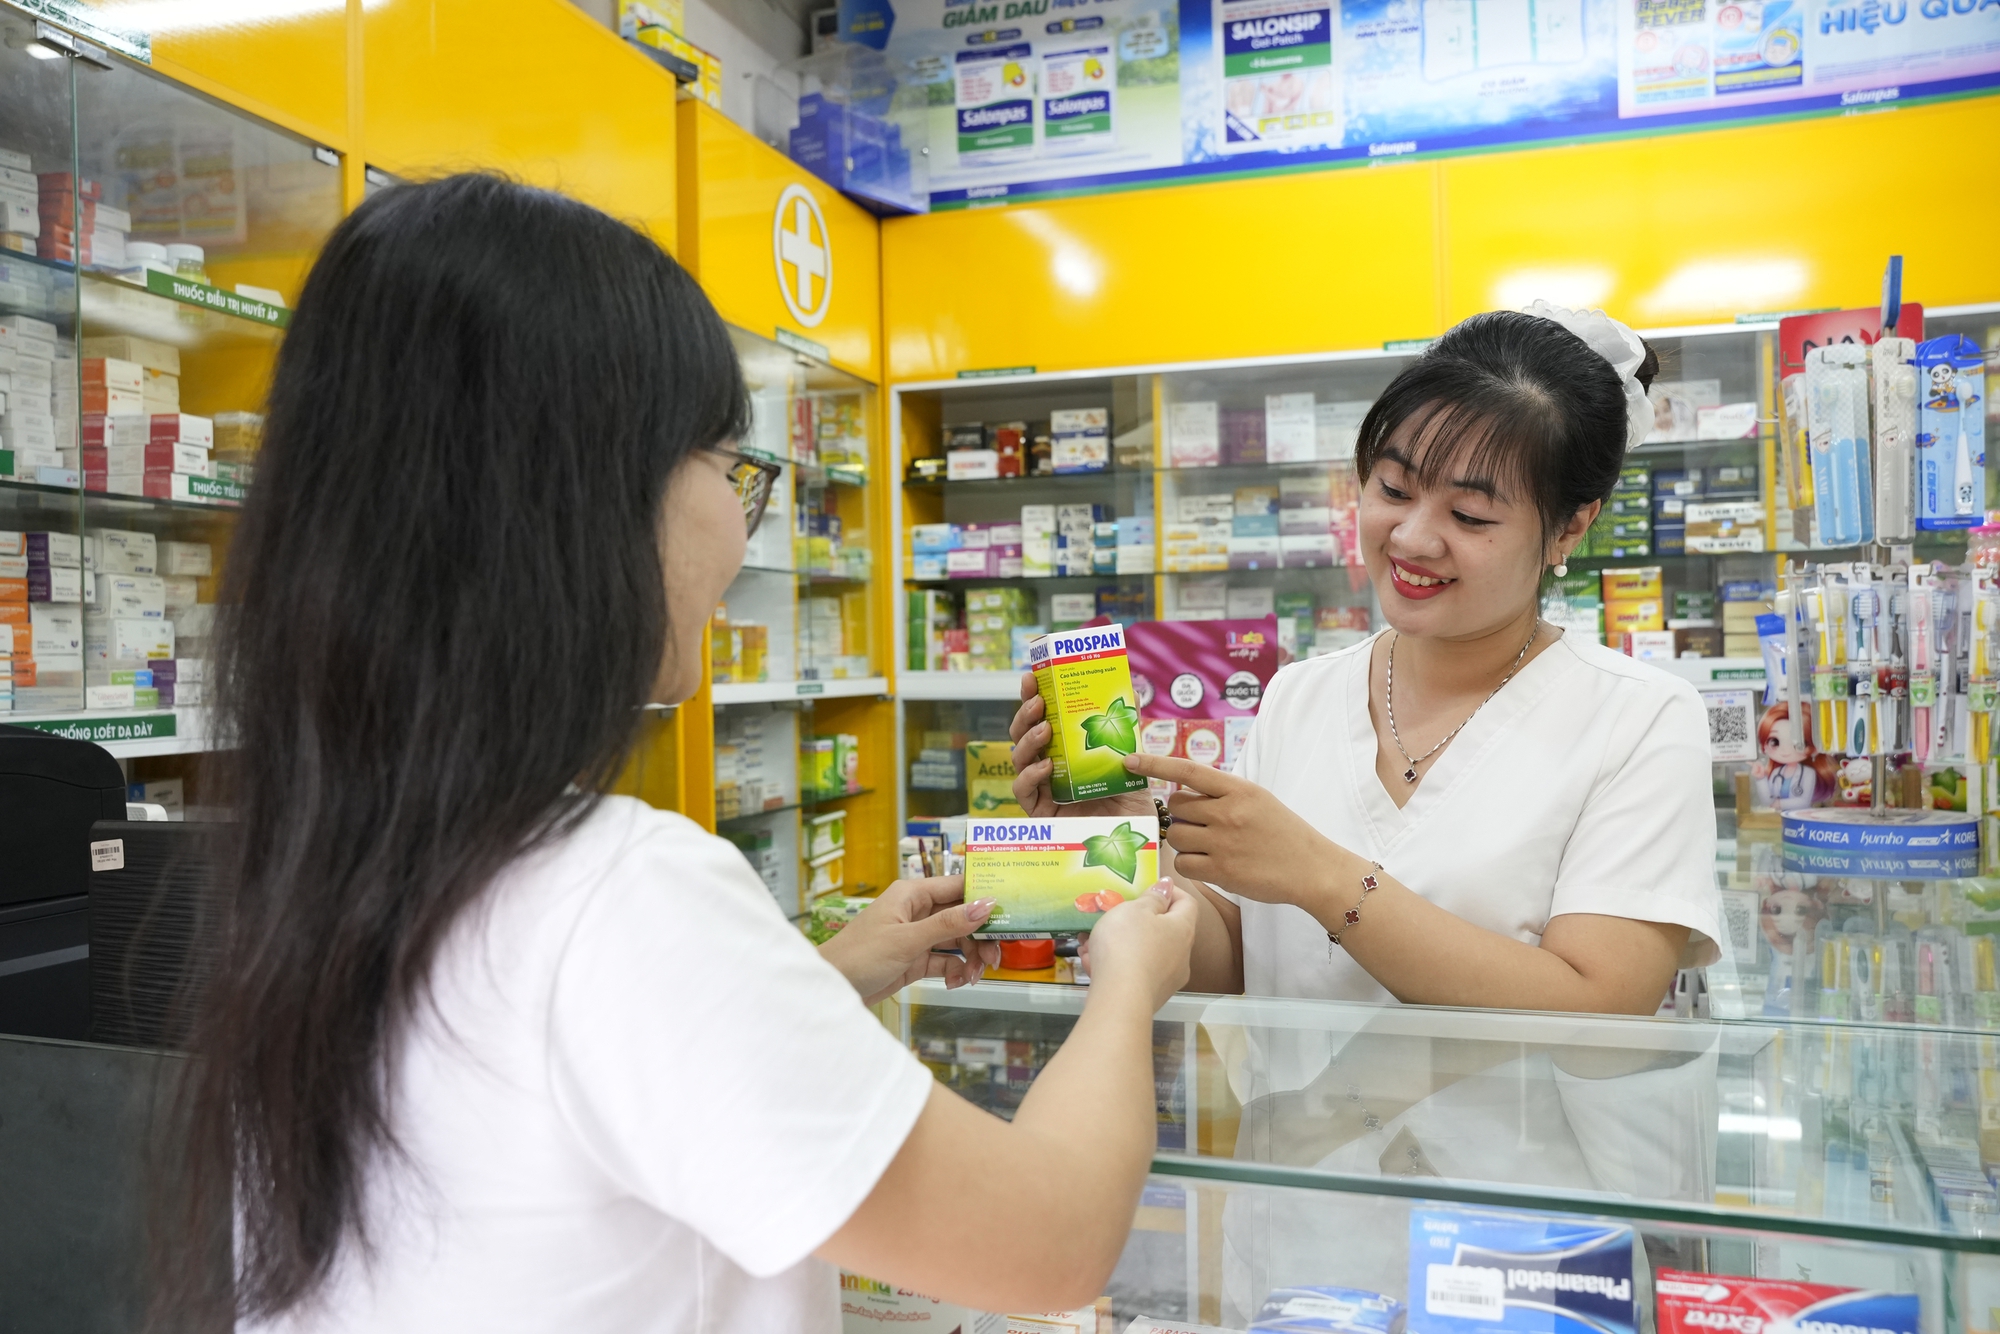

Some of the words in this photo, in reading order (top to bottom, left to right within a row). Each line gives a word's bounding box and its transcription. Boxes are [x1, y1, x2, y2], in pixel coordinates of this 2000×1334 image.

[1232, 12, 1322, 41] SALONSIP
[1251, 33, 1304, 50] Gel-Patch
[1840, 87, 1900, 106] Salonpas
[961, 104, 1028, 128] Salonpas
[1047, 96, 1106, 117] Salonpas
[173, 282, 205, 301] THUỐC
[227, 297, 240, 315] TRỊ
[193, 481, 222, 496] THUỐC
[1030, 643, 1050, 662] PROSPAN
[1054, 632, 1120, 656] PROSPAN
[94, 723, 116, 739] LOÉT
[118, 725, 132, 740] DẠ
[134, 721, 153, 737] DÀY
[978, 761, 1016, 776] Actis
[973, 825, 1052, 842] PROSPAN
[1808, 830, 1850, 844] KOREA
[1954, 830, 1976, 844] KORE
[1507, 1268, 1632, 1301] Phaanedol
[1684, 1309, 1764, 1334] Extra
